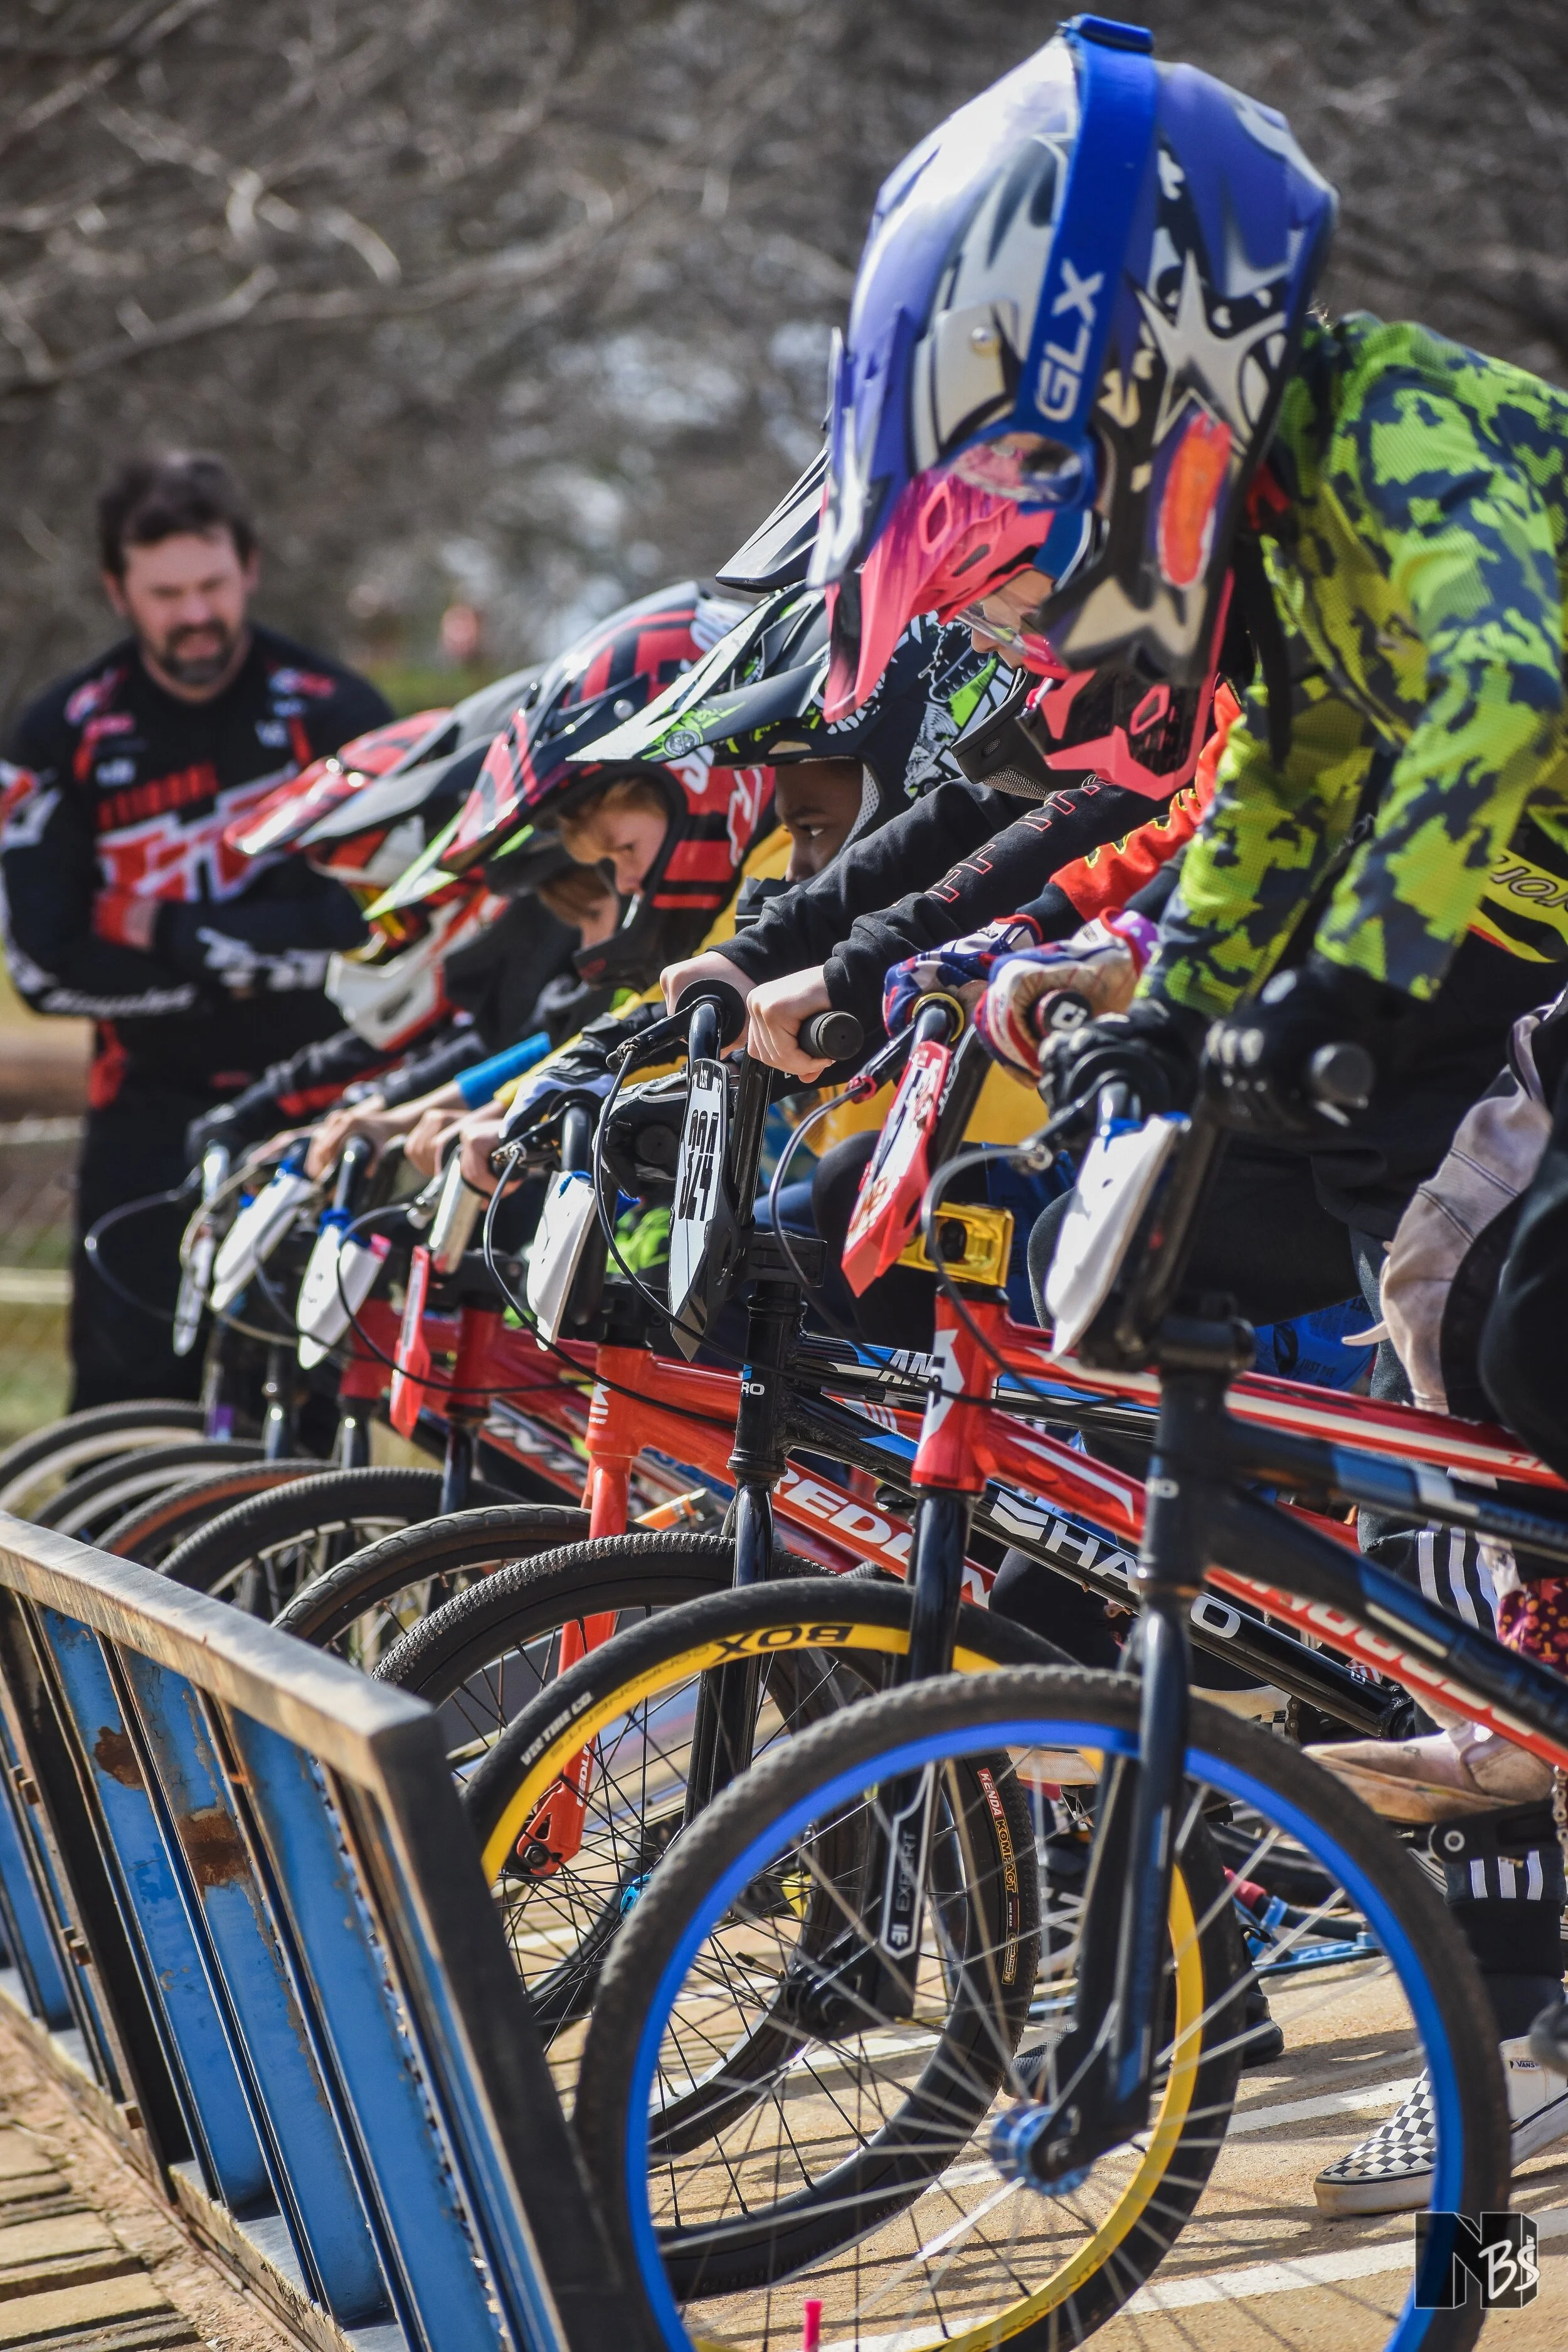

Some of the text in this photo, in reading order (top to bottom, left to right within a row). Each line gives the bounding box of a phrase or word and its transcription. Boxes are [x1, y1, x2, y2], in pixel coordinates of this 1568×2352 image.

[1035, 257, 1105, 422] GLX
[1045, 1520, 1241, 1638] HAO
[712, 1624, 855, 1664] BOX
[980, 1772, 1017, 1894] KENDA KOMPACT
[1515, 2060, 1535, 2068] VANS
